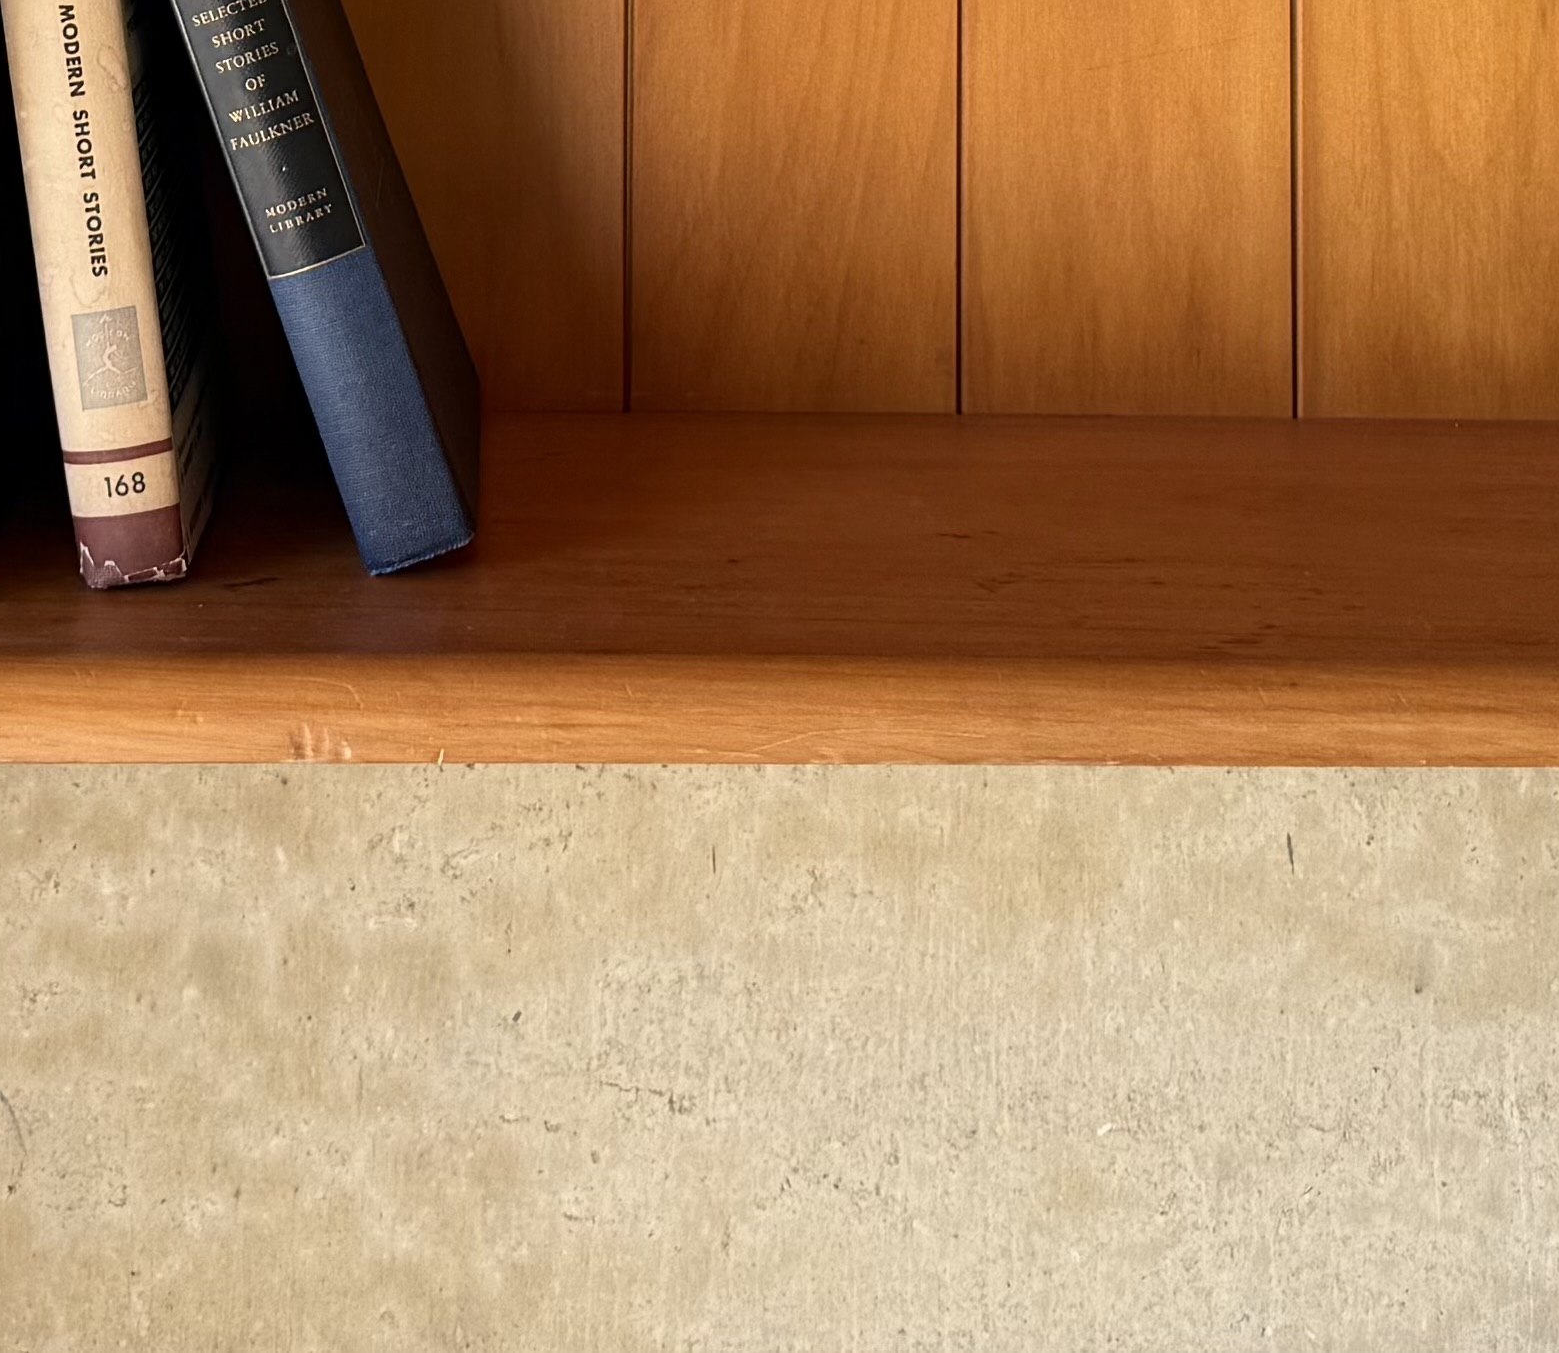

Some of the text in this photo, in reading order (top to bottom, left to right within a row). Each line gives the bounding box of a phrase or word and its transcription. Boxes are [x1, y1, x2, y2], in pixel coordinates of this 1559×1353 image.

[211, 18, 266, 49] SHORT
[58, 3, 88, 99] MODERN
[215, 41, 280, 75] STORIES
[244, 73, 267, 92] OF
[228, 88, 301, 124] WILLIAM
[73, 109, 97, 183] SHORT
[230, 111, 316, 151] FAULKNER
[265, 187, 329, 219] MODERN
[269, 203, 334, 234] LIBRARY
[84, 193, 109, 278] STORIES
[104, 472, 147, 500] 168
